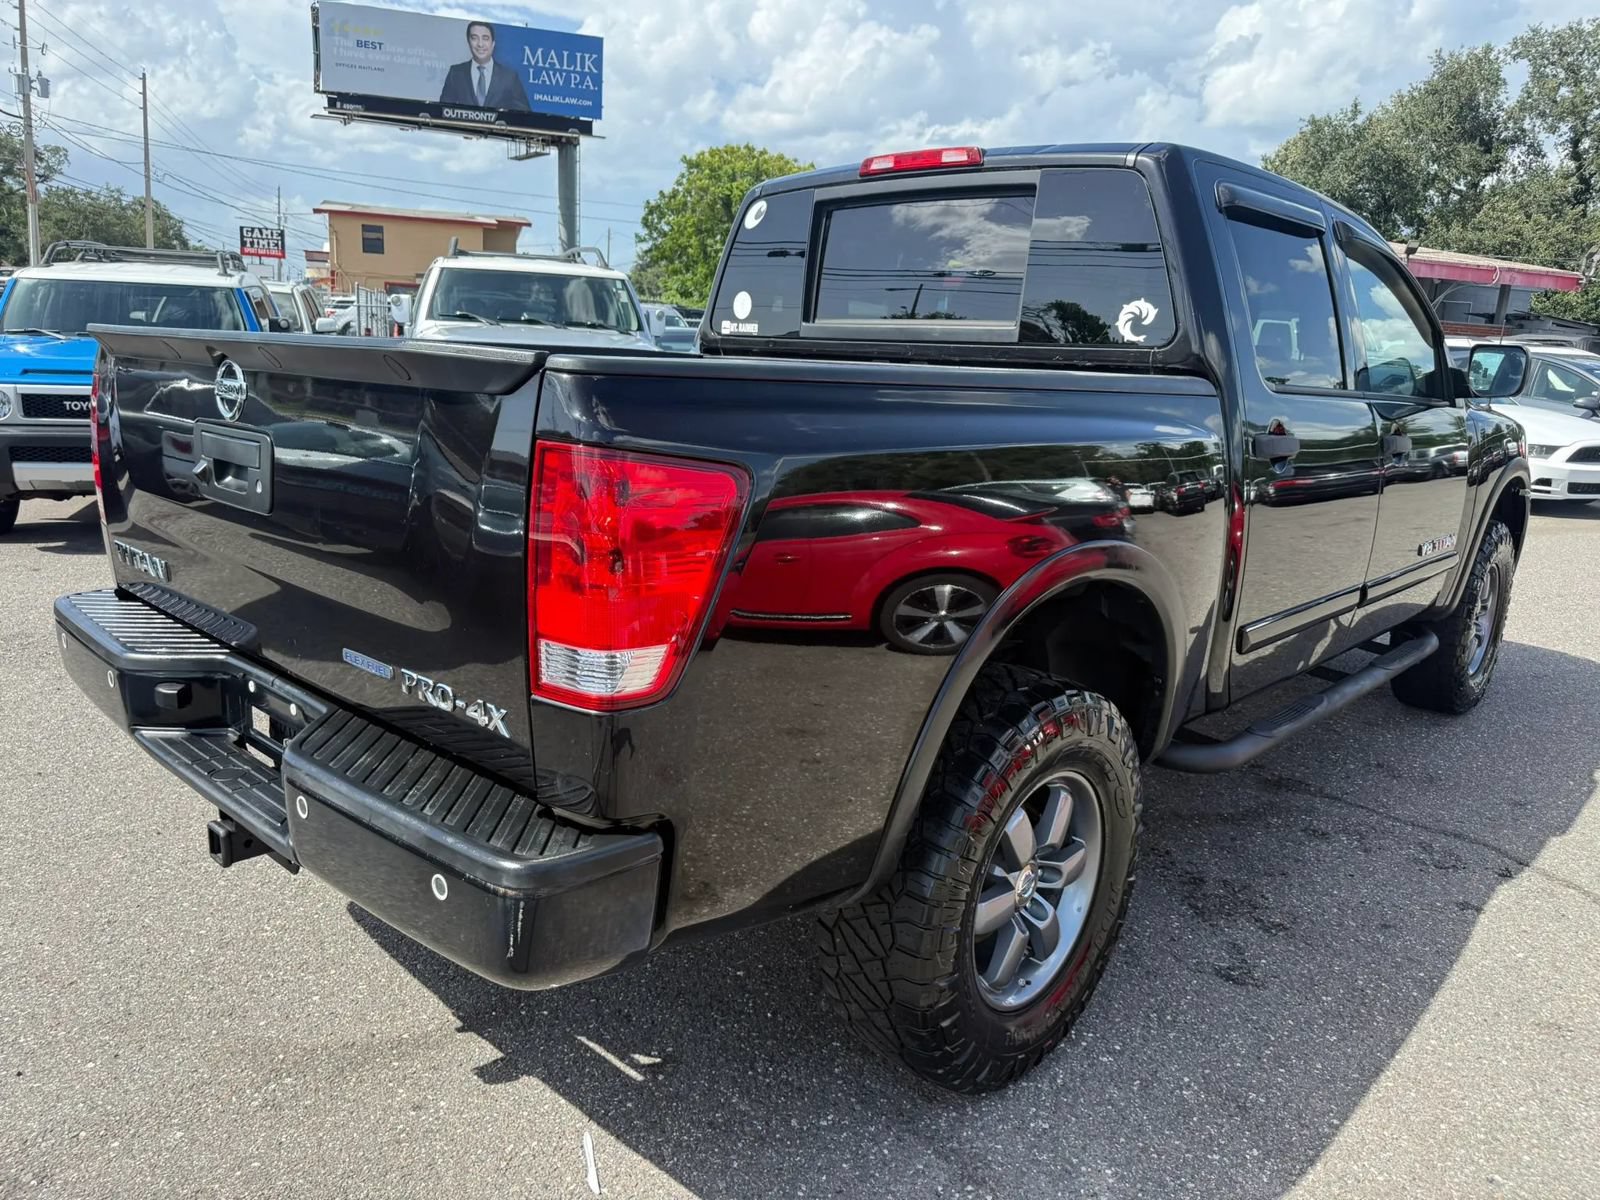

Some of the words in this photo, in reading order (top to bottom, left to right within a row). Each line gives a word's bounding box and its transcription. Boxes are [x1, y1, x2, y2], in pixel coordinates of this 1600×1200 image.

[356, 39, 384, 50] BEST
[522, 45, 598, 73] MALIK
[528, 68, 566, 86] LAW
[570, 73, 598, 90] P.A.
[243, 227, 281, 240] GAME
[243, 237, 282, 250] TIME!
[63, 401, 91, 411] TOY
[113, 540, 171, 582] TITAN
[401, 668, 510, 738] PRO-4X
